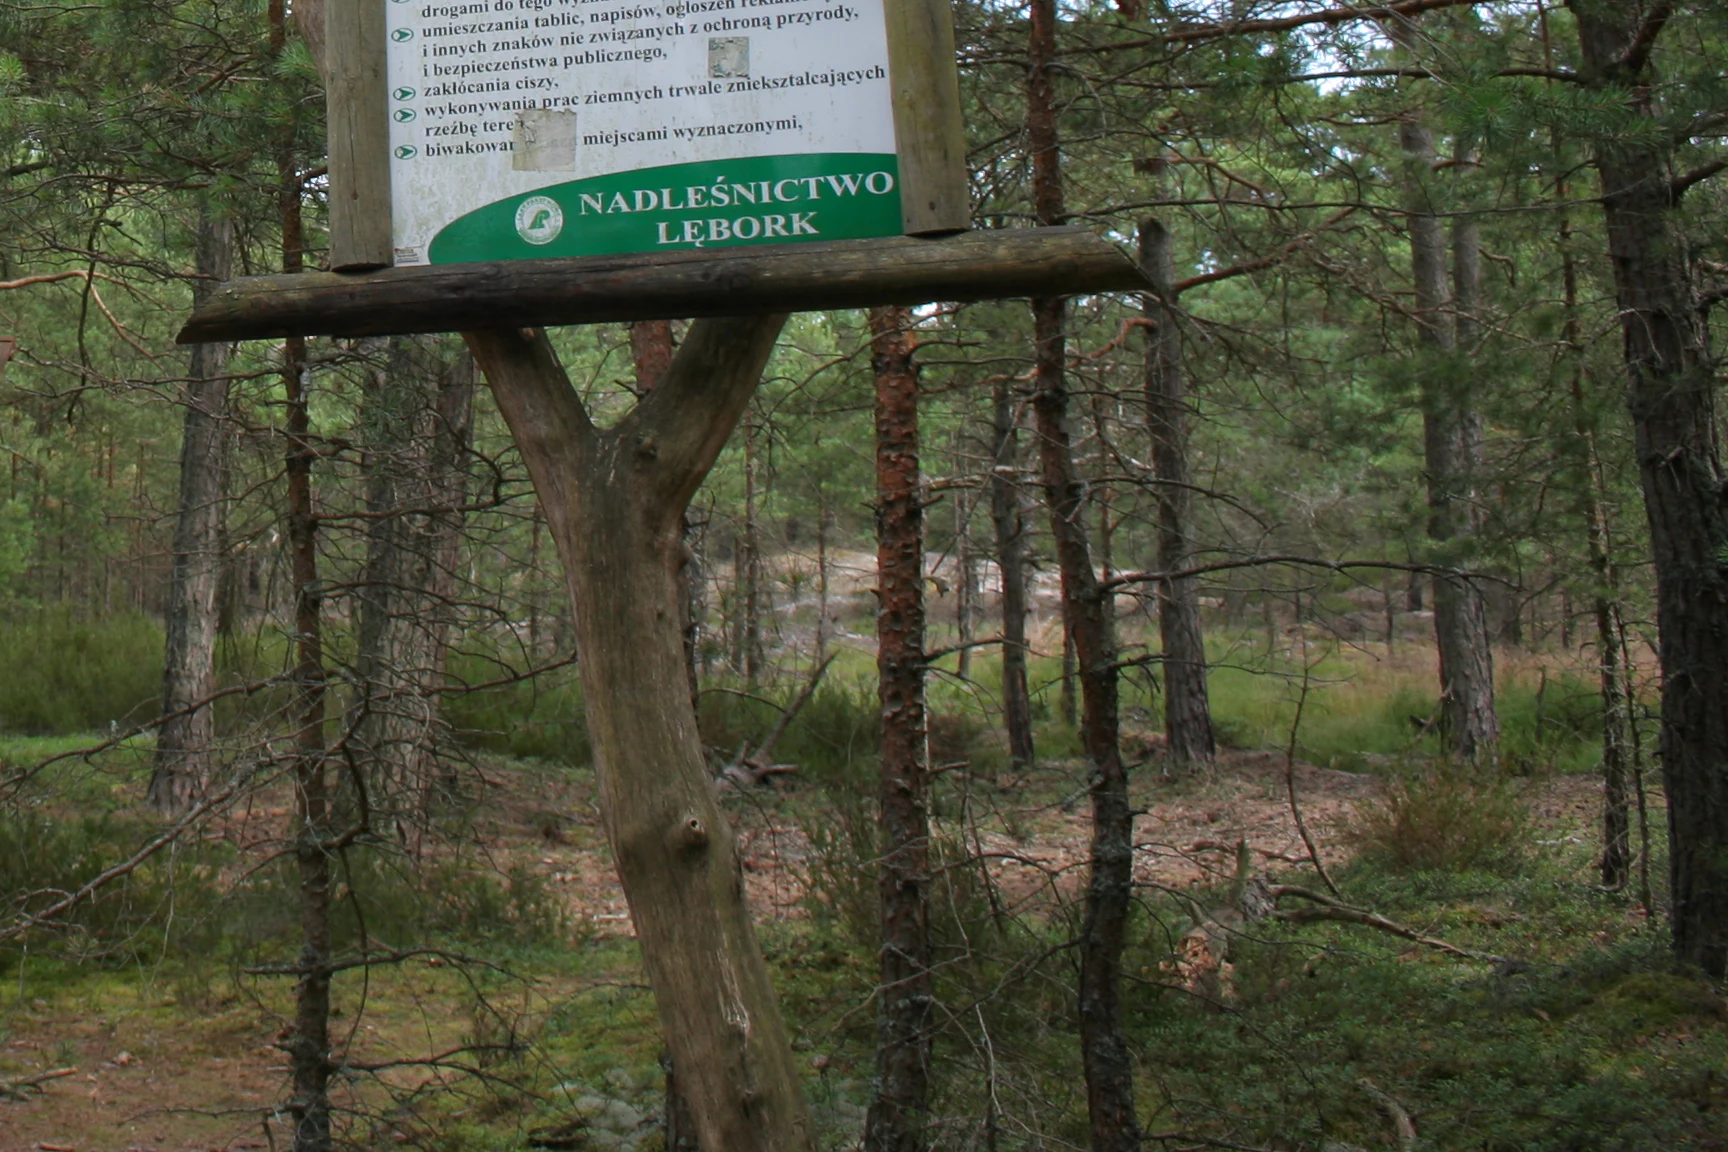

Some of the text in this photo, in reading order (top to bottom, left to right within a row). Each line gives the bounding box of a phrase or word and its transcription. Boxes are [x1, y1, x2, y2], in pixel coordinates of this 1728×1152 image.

[421, 15, 530, 38] umieszczania
[533, 11, 585, 29] tablic,
[589, 3, 662, 26] napisów,
[422, 3, 859, 58] i innych znaków nie związanych z ochroną przyrody,
[422, 46, 668, 79] i bezpieczeństwa publicznego,
[423, 74, 559, 98] zakłócania ciszy,
[423, 94, 537, 117] wykonywania
[541, 94, 580, 111] prac
[583, 84, 664, 105] ziemnych
[667, 73, 723, 98] trwale
[424, 119, 478, 138] rzeźbę
[582, 124, 668, 148] miejscami
[672, 114, 804, 139] wyznaczonymi,
[578, 171, 895, 216] NADLEŚNICTWO
[656, 211, 820, 247] LĘBORK
